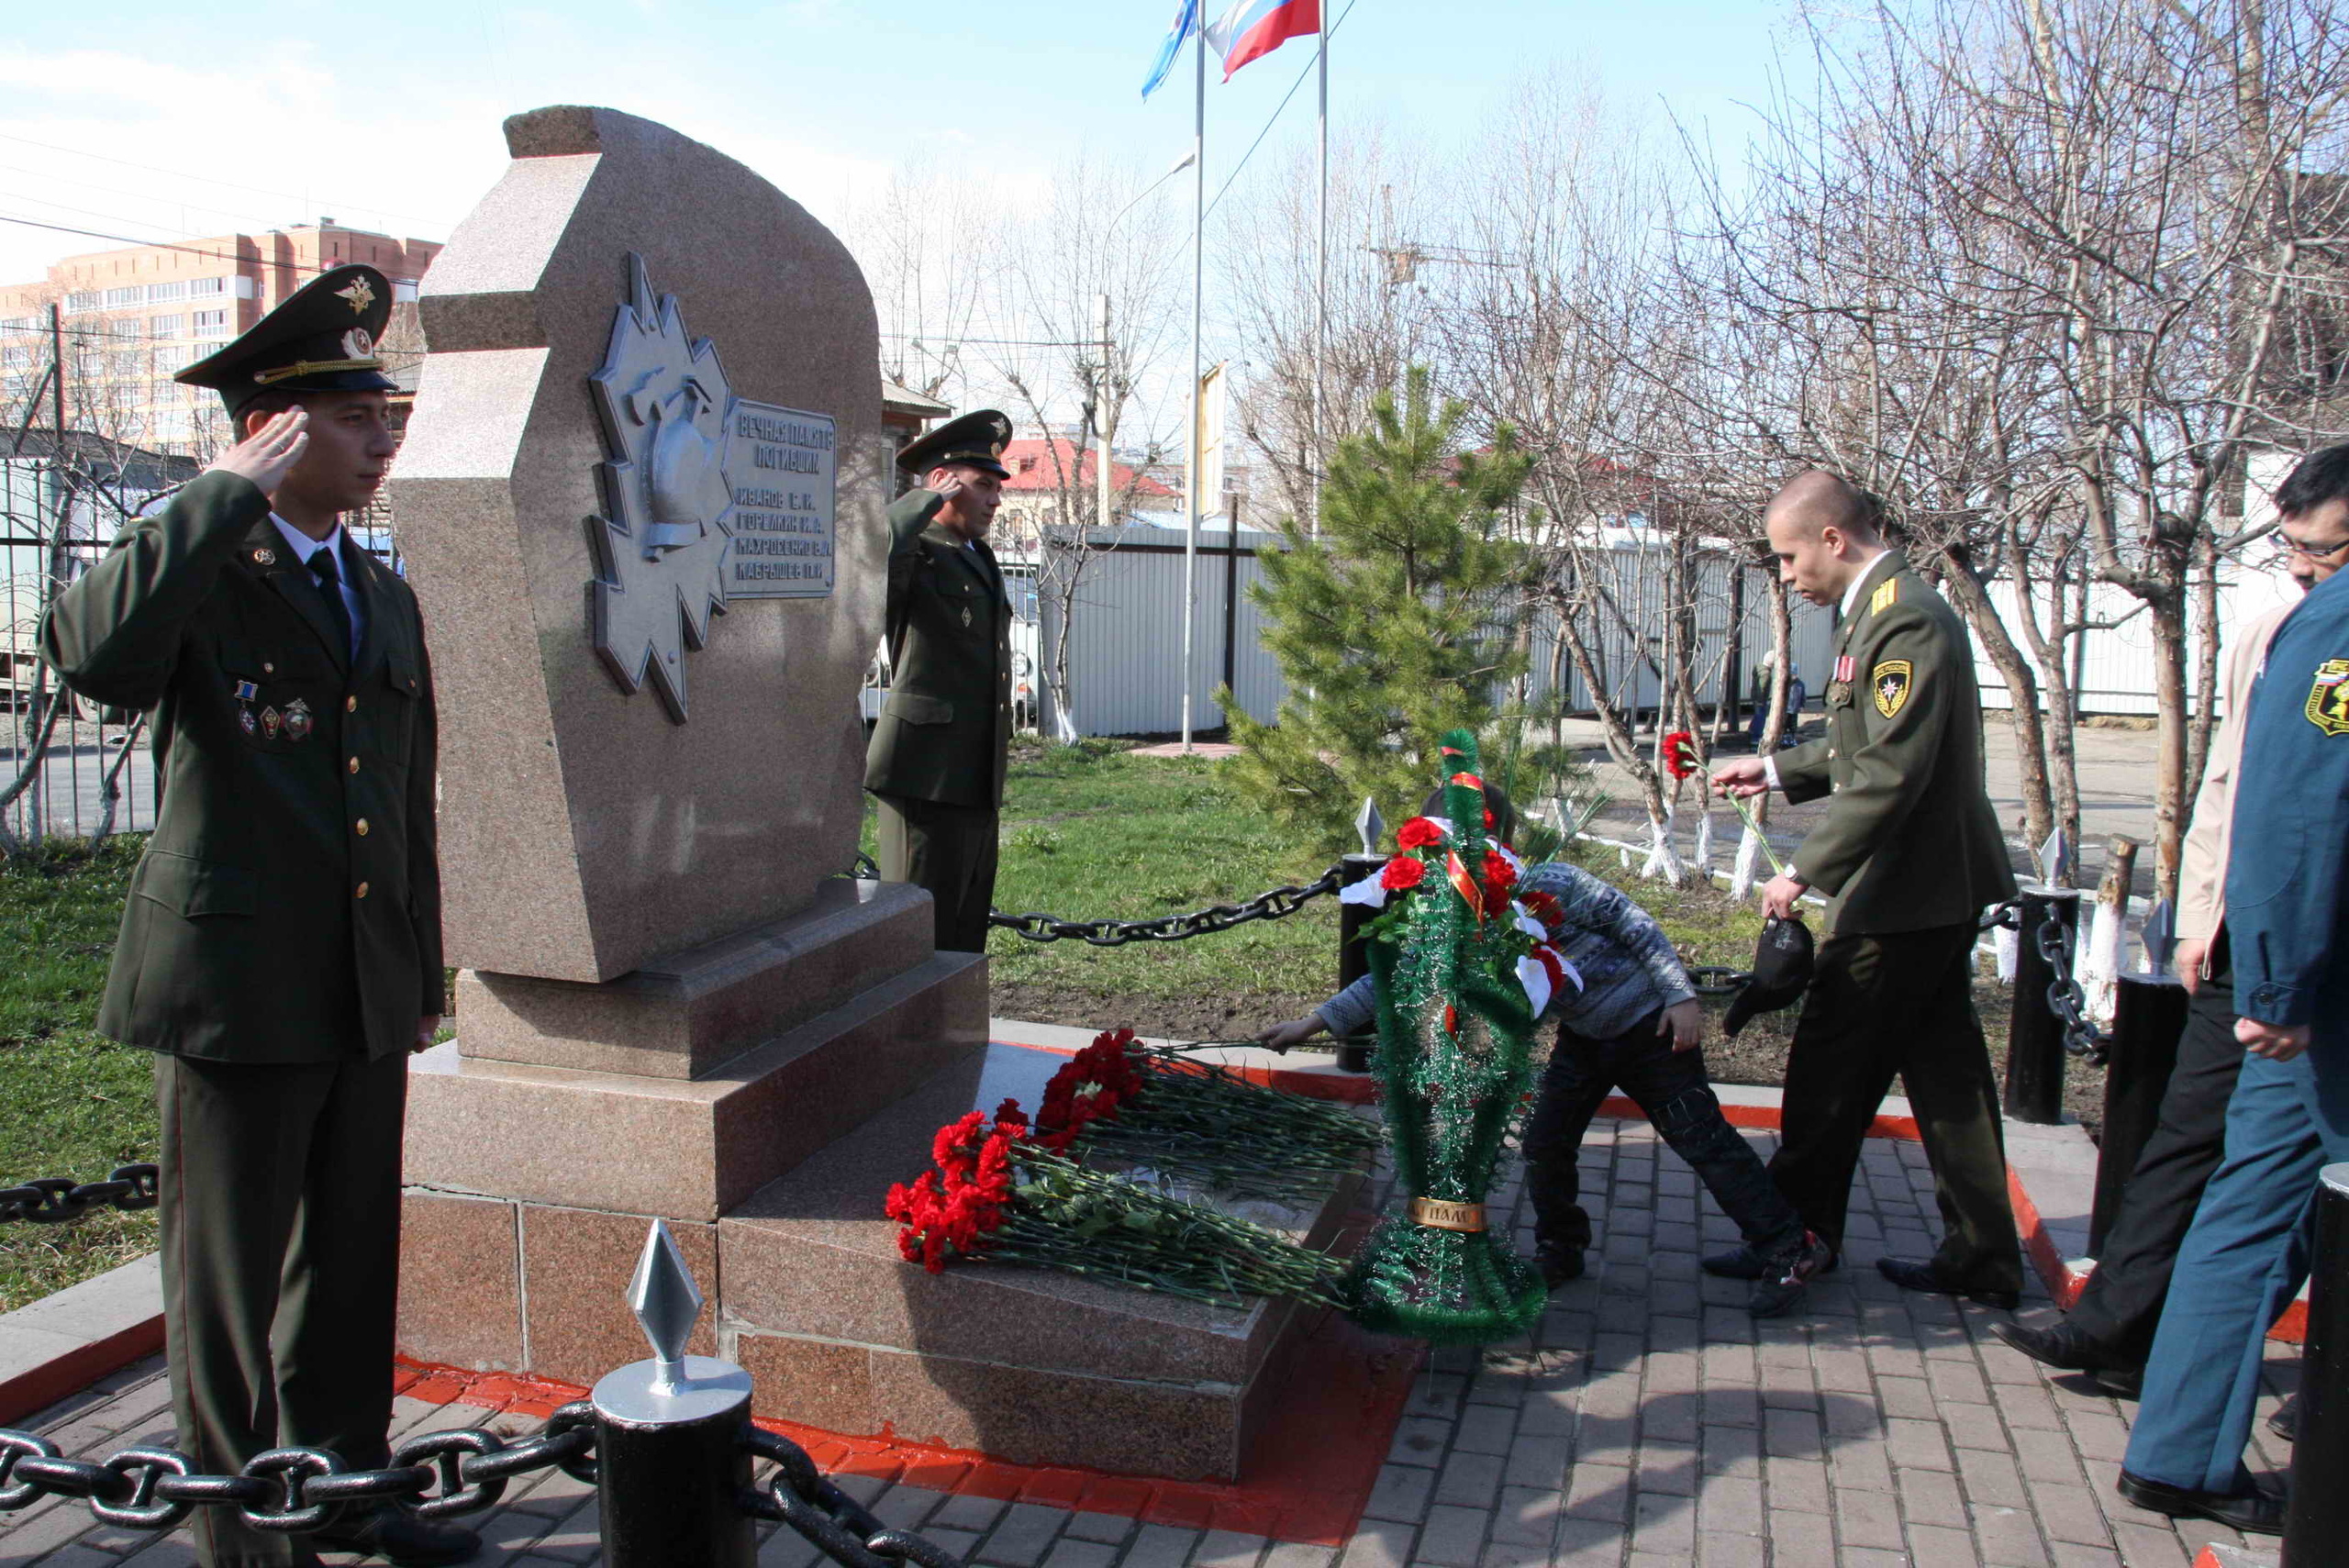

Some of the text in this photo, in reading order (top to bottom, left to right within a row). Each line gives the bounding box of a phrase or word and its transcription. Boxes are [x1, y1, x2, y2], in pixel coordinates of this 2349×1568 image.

[738, 413, 833, 450] ВЕЧНАЯ ПАМЯТЬ
[755, 444, 819, 475] ПОГИБШИМ
[737, 488, 784, 509] ИВАНОВ
[737, 513, 796, 532] ГОРЕЛКИН
